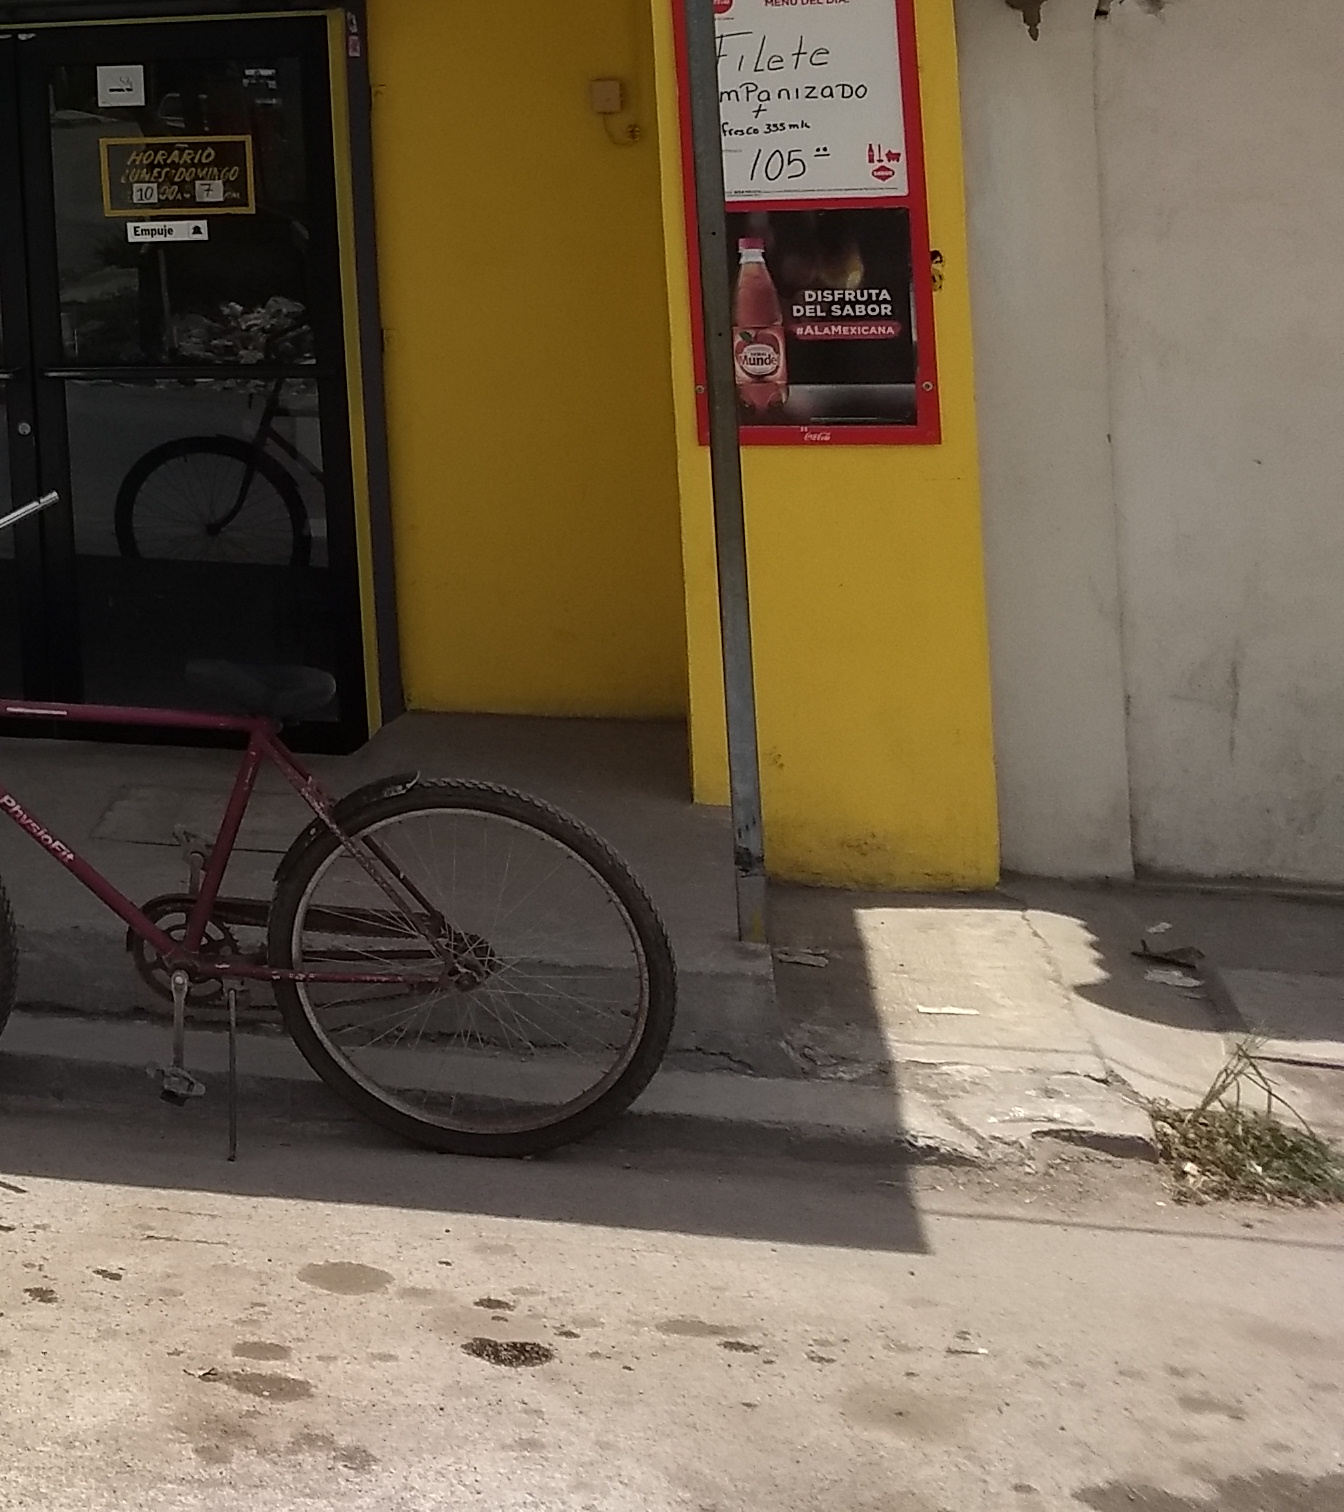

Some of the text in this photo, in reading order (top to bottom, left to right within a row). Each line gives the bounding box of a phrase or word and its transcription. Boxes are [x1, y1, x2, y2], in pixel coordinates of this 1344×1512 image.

[126, 147, 216, 166] HORARIO
[749, 148, 807, 181] 105
[120, 166, 240, 184] LUNES DOMINGO
[136, 186, 154, 202] 10
[199, 183, 214, 198] 7
[133, 225, 174, 238] Empuje
[804, 289, 892, 303] DISFRUTA
[792, 303, 893, 317] DEL SABOR
